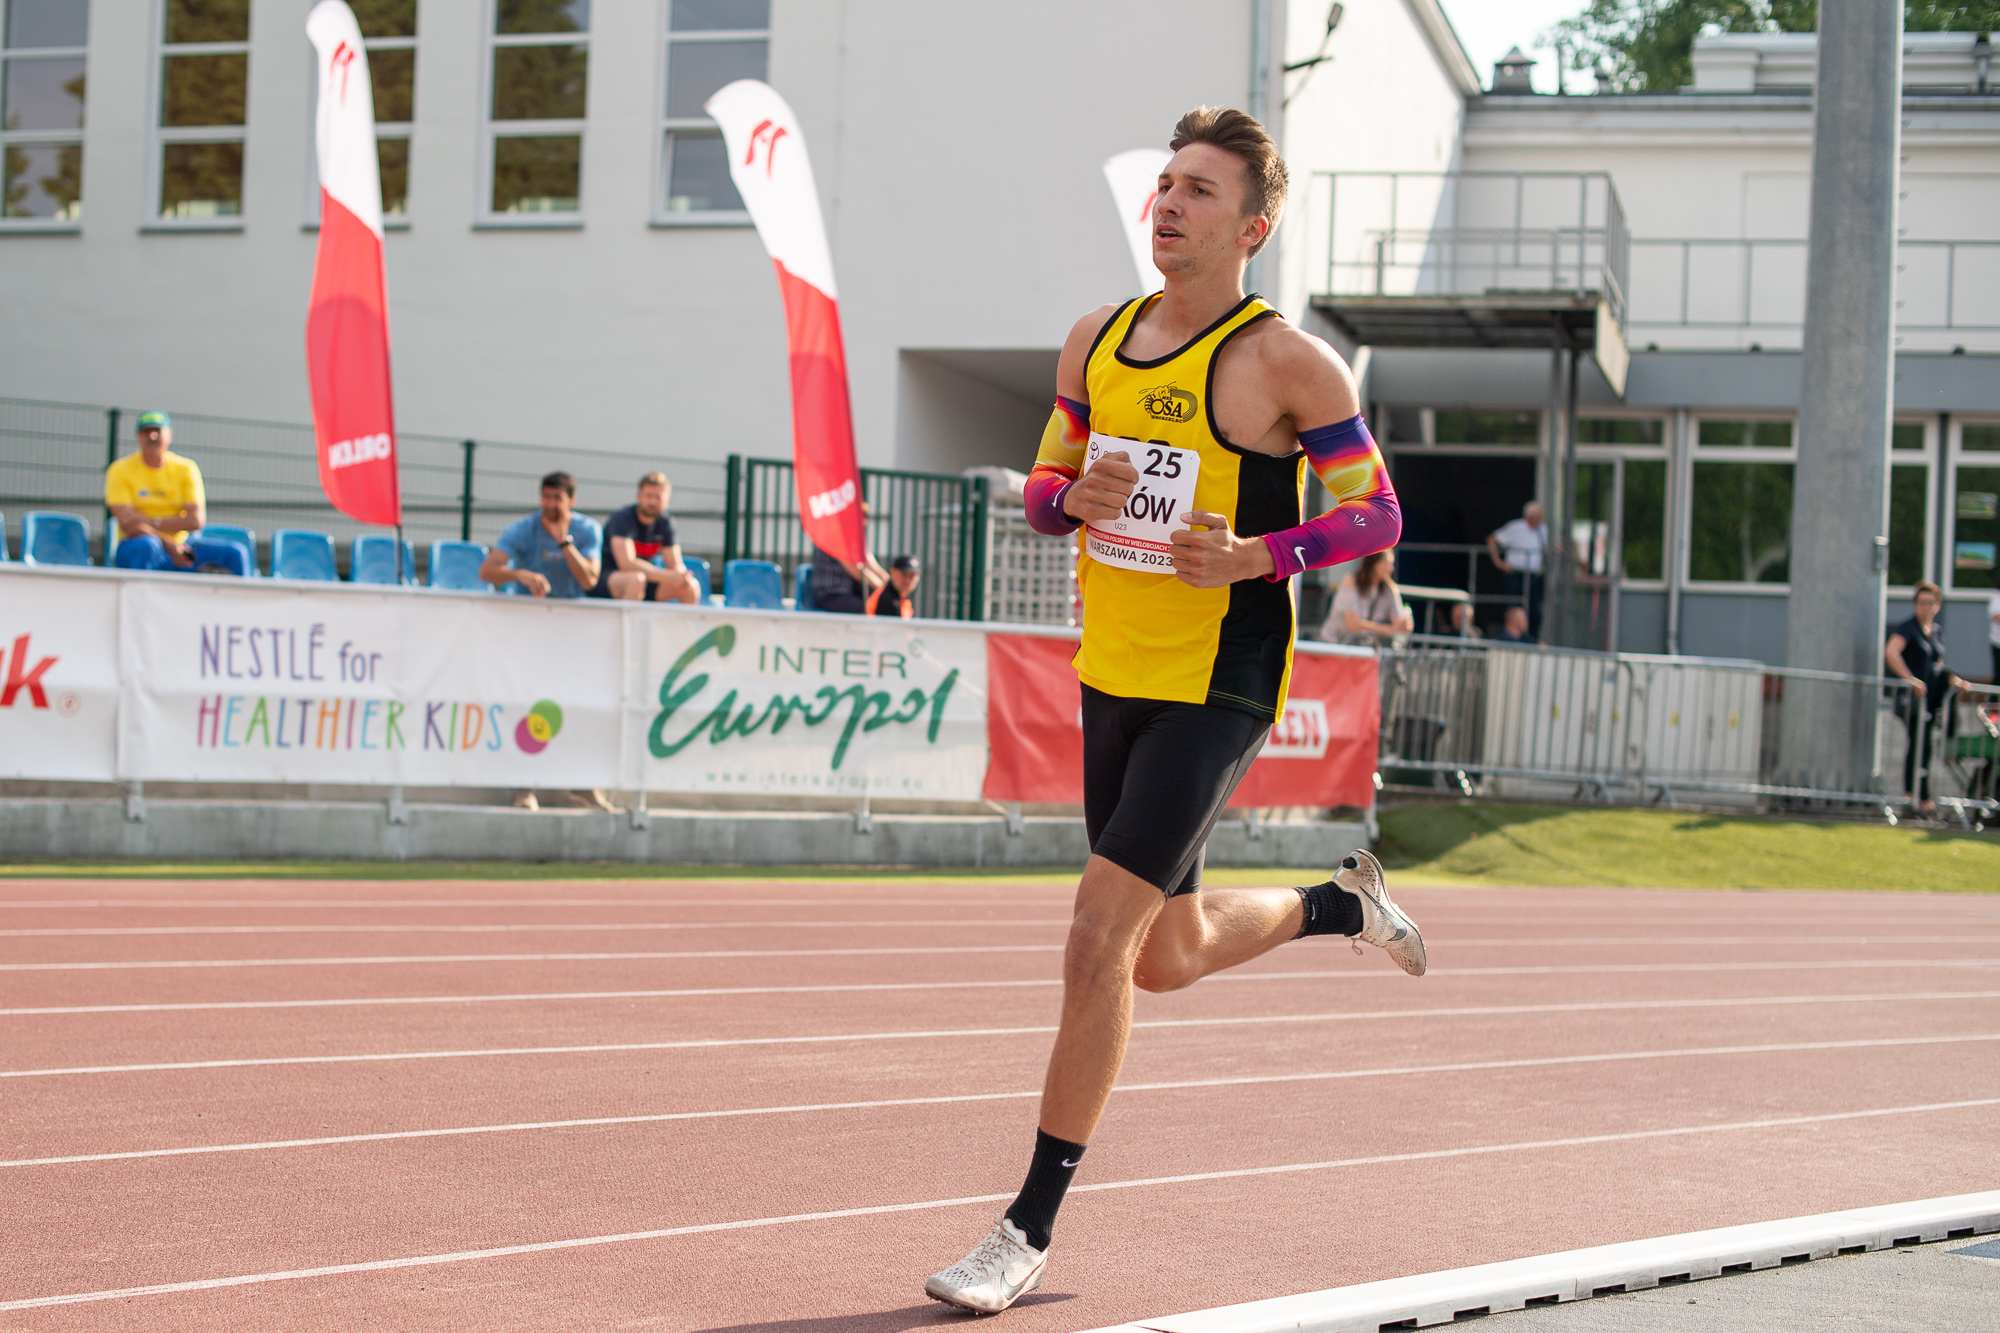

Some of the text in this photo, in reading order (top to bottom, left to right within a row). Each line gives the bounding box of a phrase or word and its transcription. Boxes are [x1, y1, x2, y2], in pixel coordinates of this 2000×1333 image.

[1150, 399, 1183, 418] OSA
[1143, 448, 1183, 479] 25
[1114, 522, 1128, 531] U23
[1140, 552, 1173, 567] 2023
[200, 622, 383, 684] NESTLÉ for
[760, 645, 907, 679] INTER
[648, 624, 959, 770] Europol
[198, 695, 504, 752] HEALTHIER KIDS
